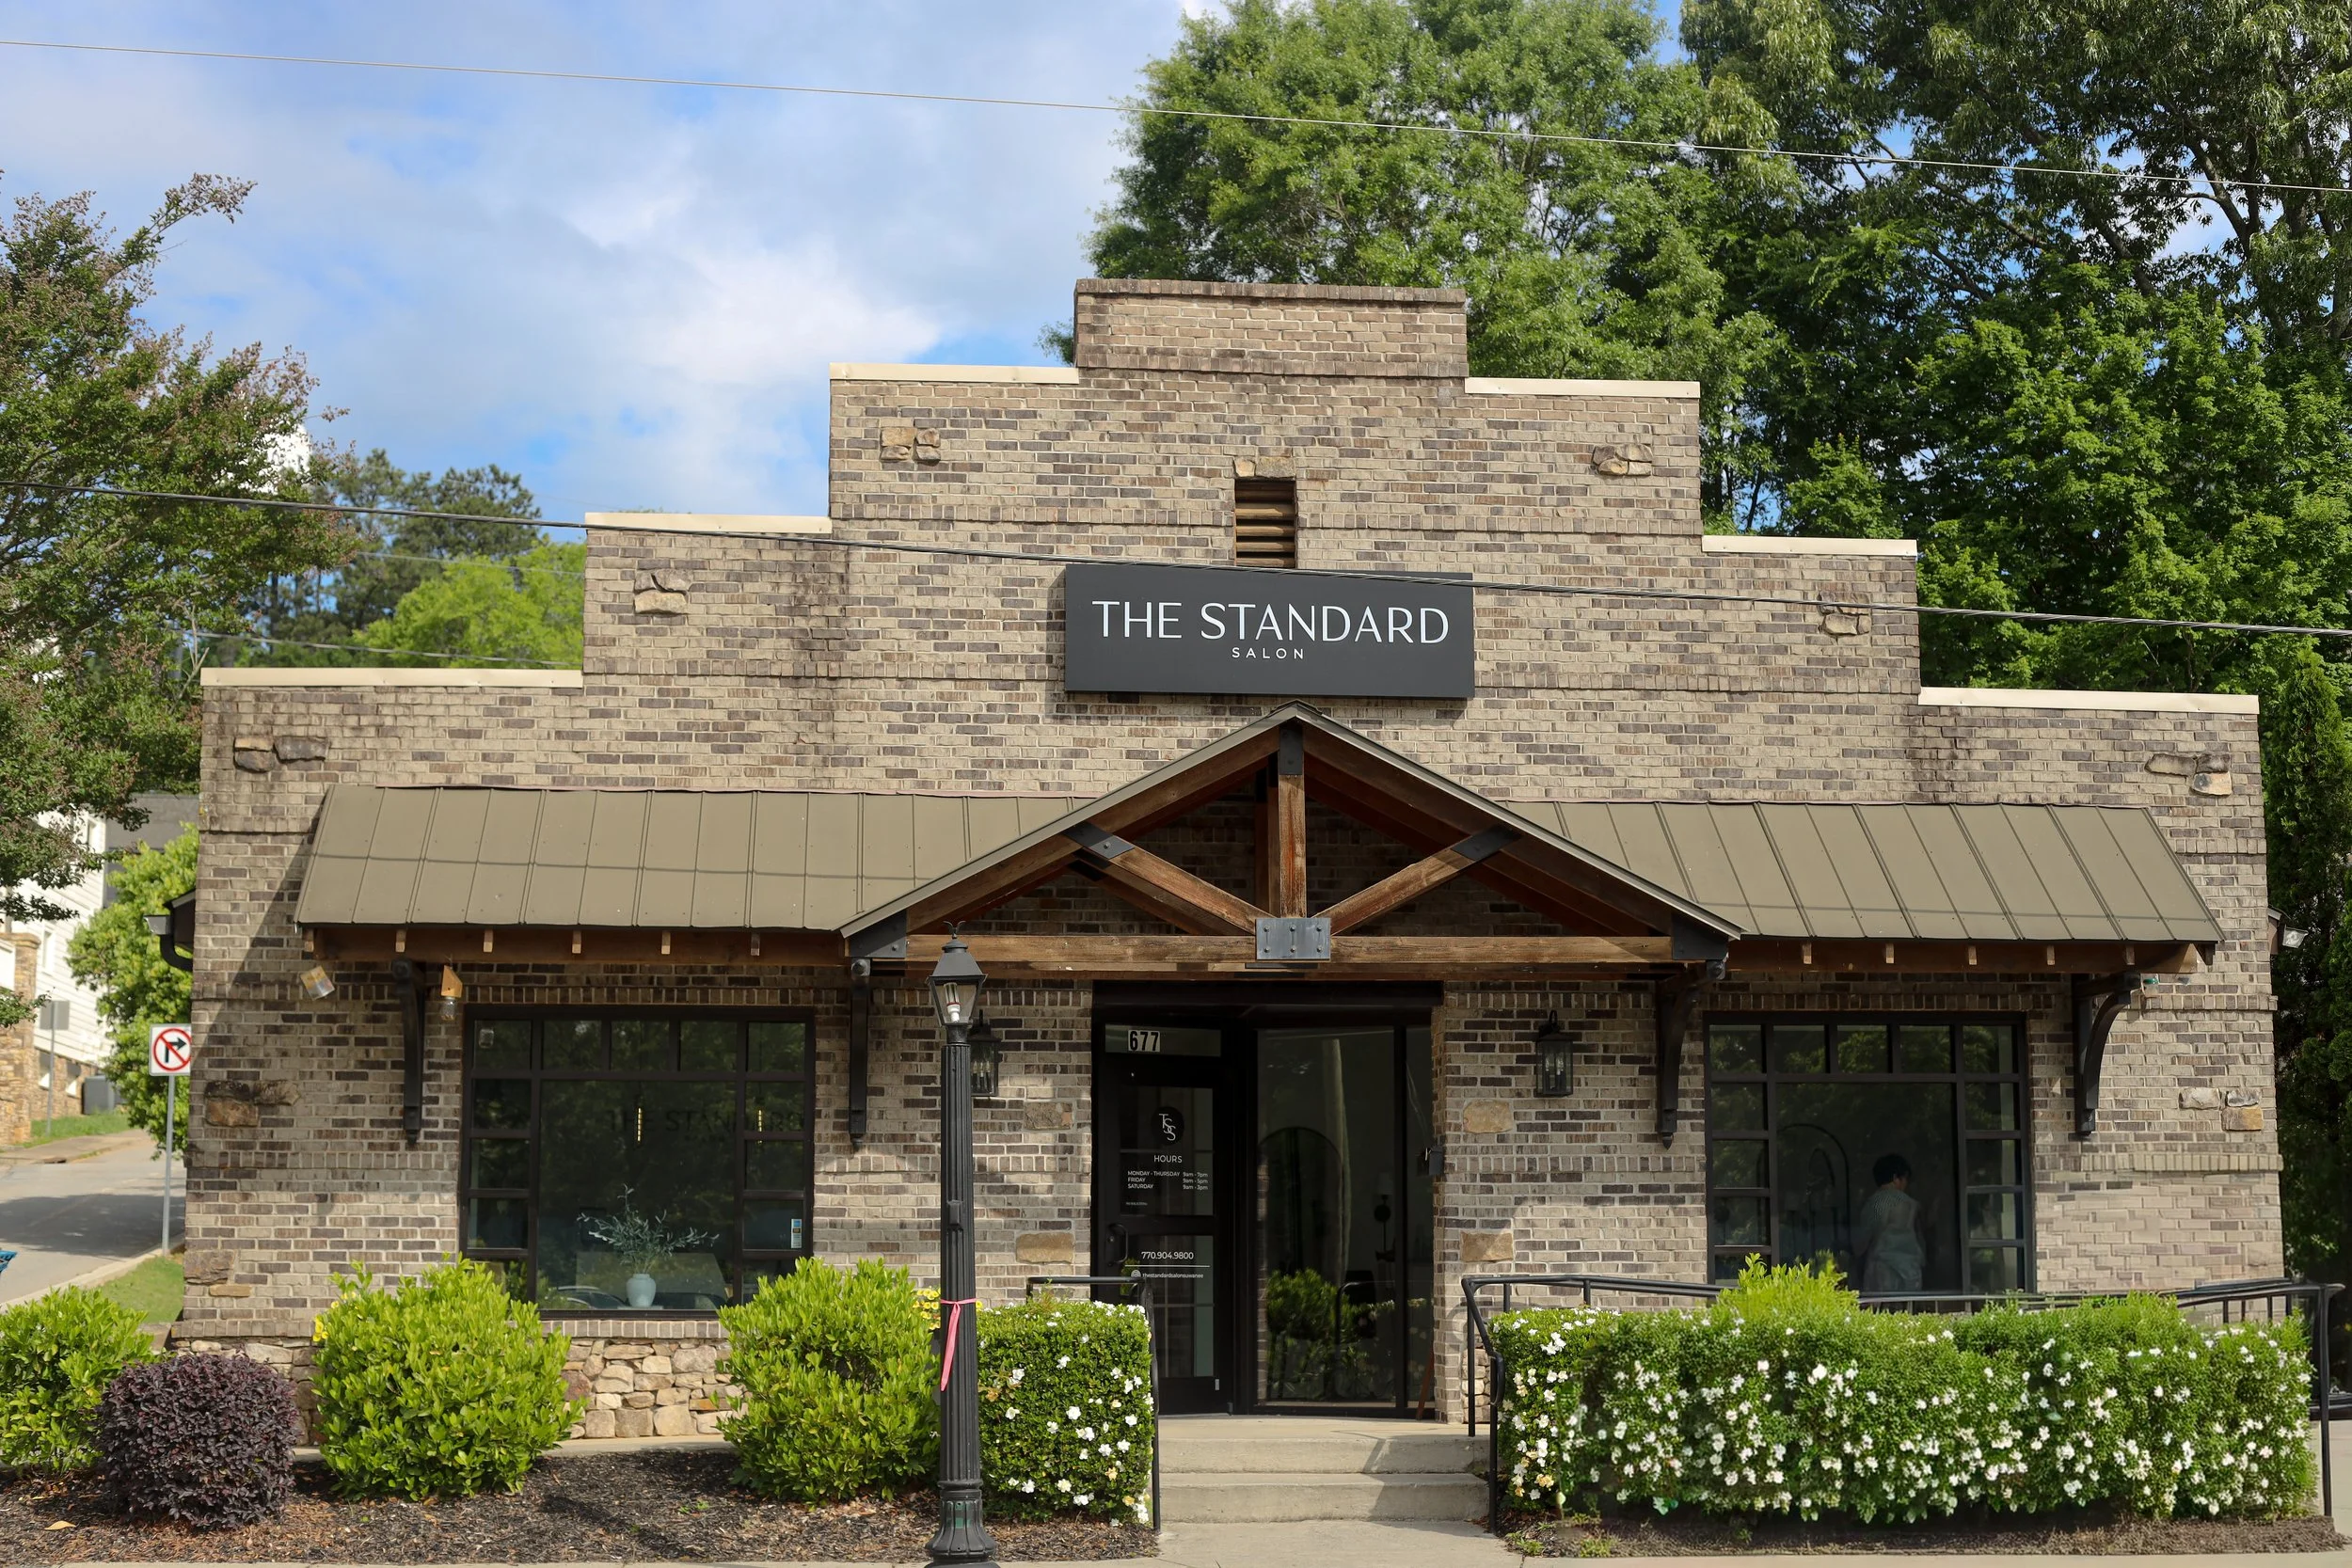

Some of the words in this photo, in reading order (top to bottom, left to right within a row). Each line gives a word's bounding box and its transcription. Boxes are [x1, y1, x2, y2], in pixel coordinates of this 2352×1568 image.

[1091, 600, 1183, 639] THE
[1200, 602, 1450, 644] STANDARD
[1232, 647, 1305, 659] SALON
[1130, 1031, 1159, 1052] 677
[1153, 1155, 1183, 1164] HOURS
[1140, 1251, 1195, 1259] 770.904.9800
